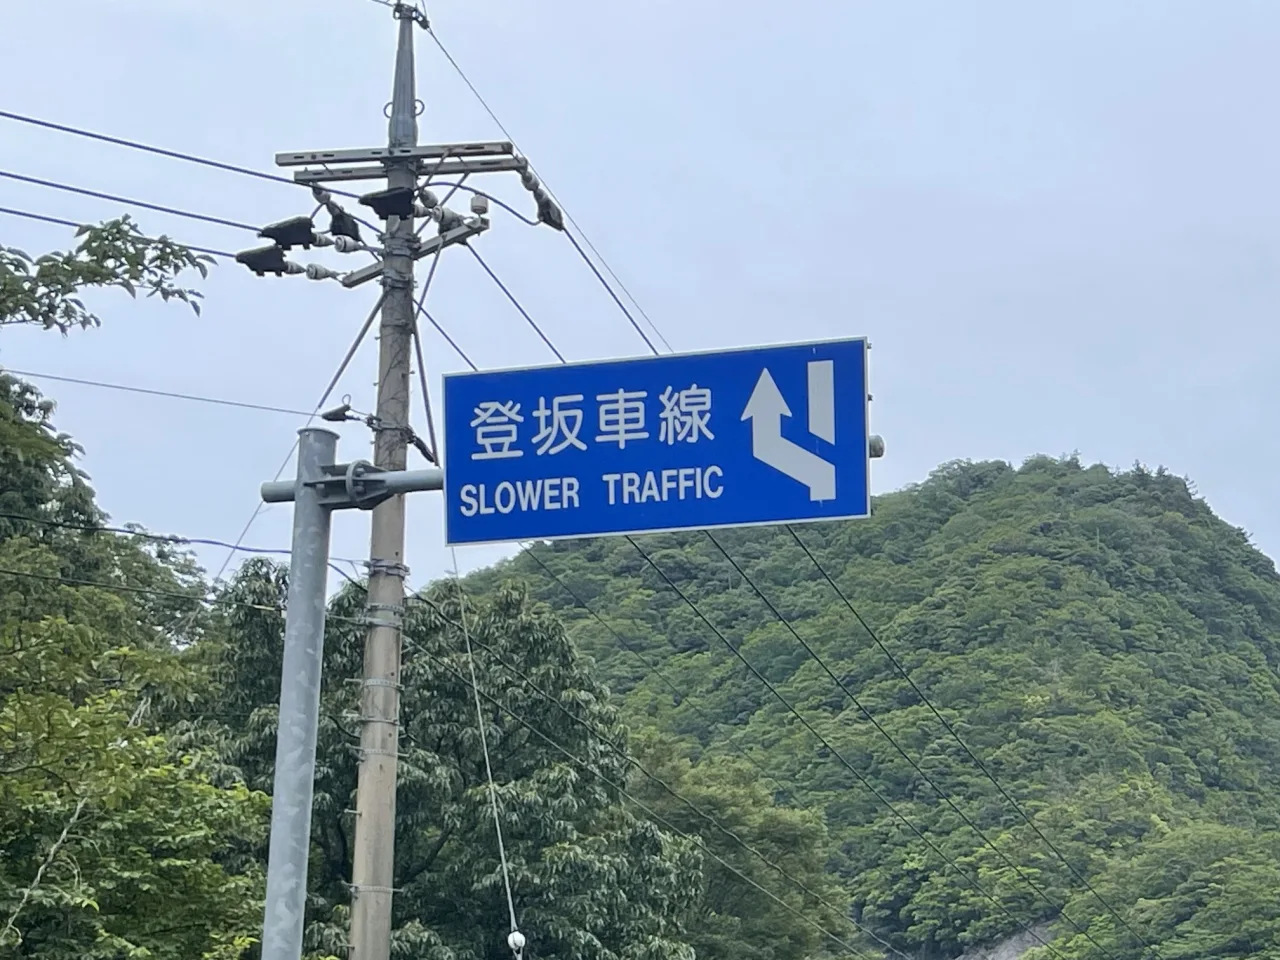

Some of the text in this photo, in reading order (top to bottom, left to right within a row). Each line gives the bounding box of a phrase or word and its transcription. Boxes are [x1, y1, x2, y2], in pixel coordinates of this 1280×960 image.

[470, 383, 715, 460] 登坂車線
[460, 465, 724, 517] SLOWER TRAFFIC
